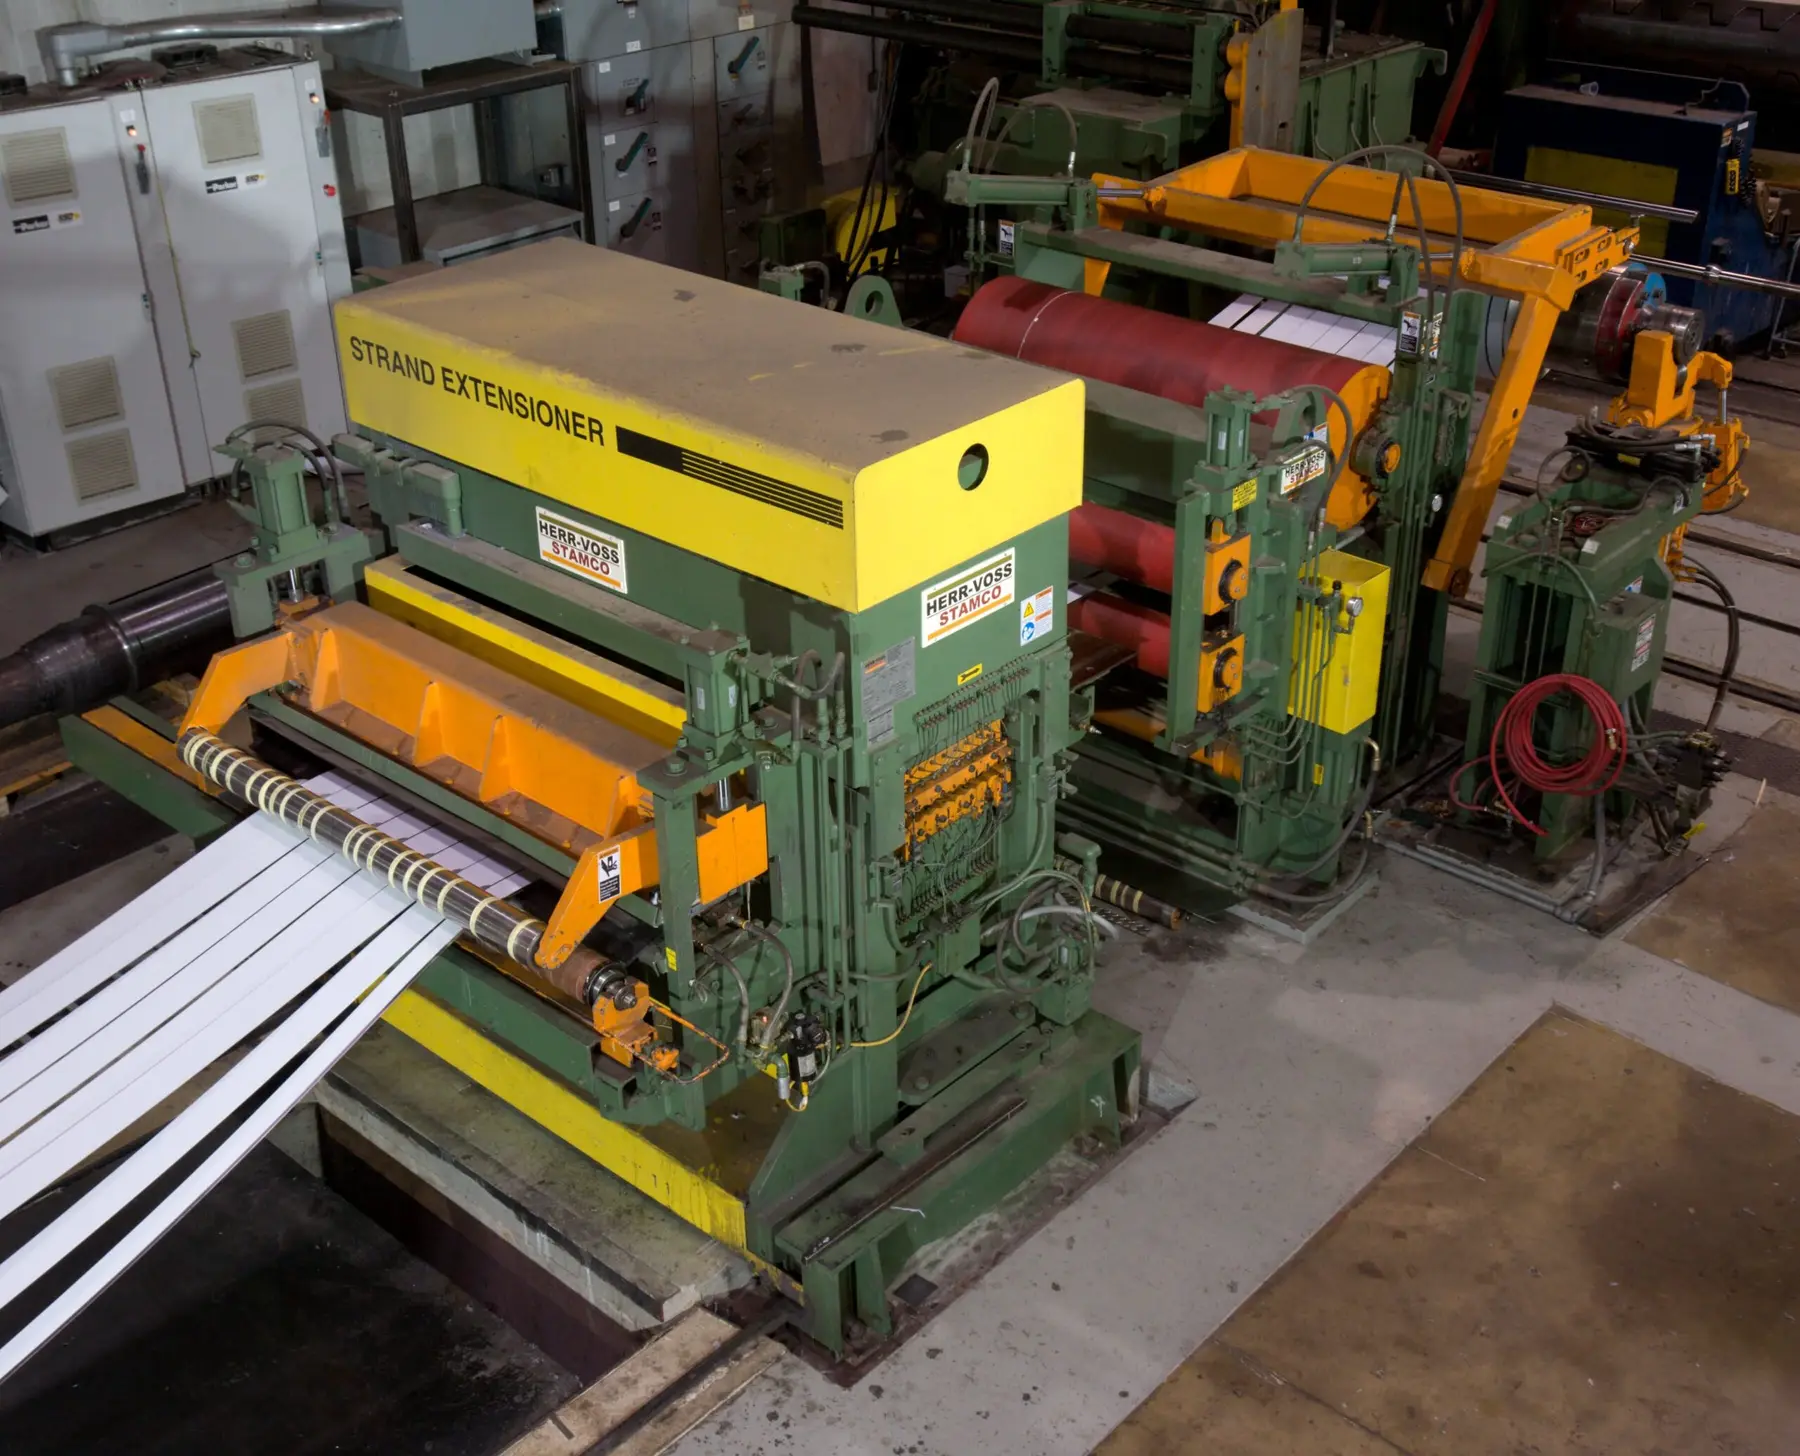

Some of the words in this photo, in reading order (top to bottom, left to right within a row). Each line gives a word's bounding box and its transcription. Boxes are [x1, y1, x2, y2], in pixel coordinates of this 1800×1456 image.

[350, 335, 435, 386] STRAND
[441, 366, 604, 446] EXTENSIONER
[539, 520, 619, 564] HERR-VOSS
[552, 541, 610, 575] STAMCO
[926, 563, 1012, 616] HERR-VOSS
[939, 585, 1001, 626] STAMCO
